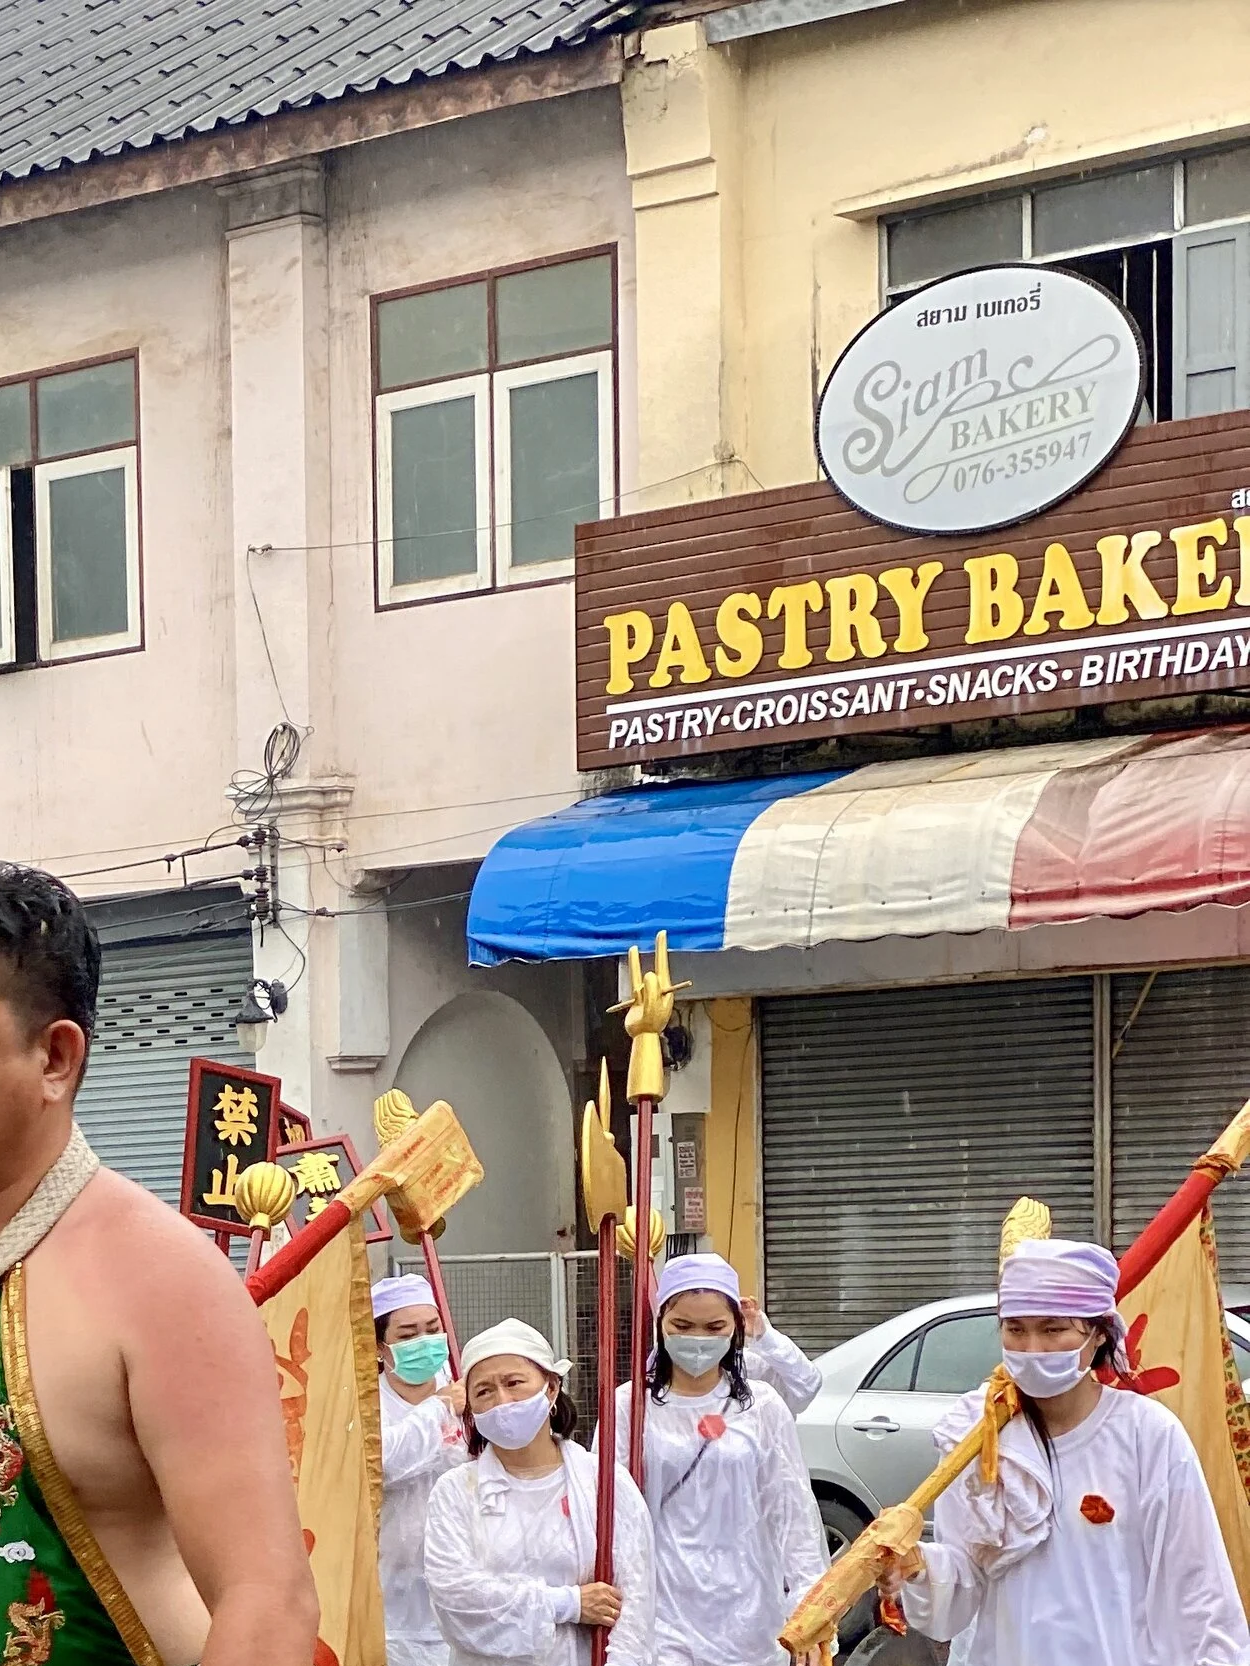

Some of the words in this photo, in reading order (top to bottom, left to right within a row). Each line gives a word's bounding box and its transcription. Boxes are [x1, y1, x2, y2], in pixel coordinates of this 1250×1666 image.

[916, 305, 967, 328] สยาม
[976, 281, 1042, 319] เบเกอรี่
[842, 347, 989, 478] Siam
[950, 381, 1097, 452] BAKERY
[953, 432, 1092, 493] 076-355947
[603, 561, 944, 695] PASTRY
